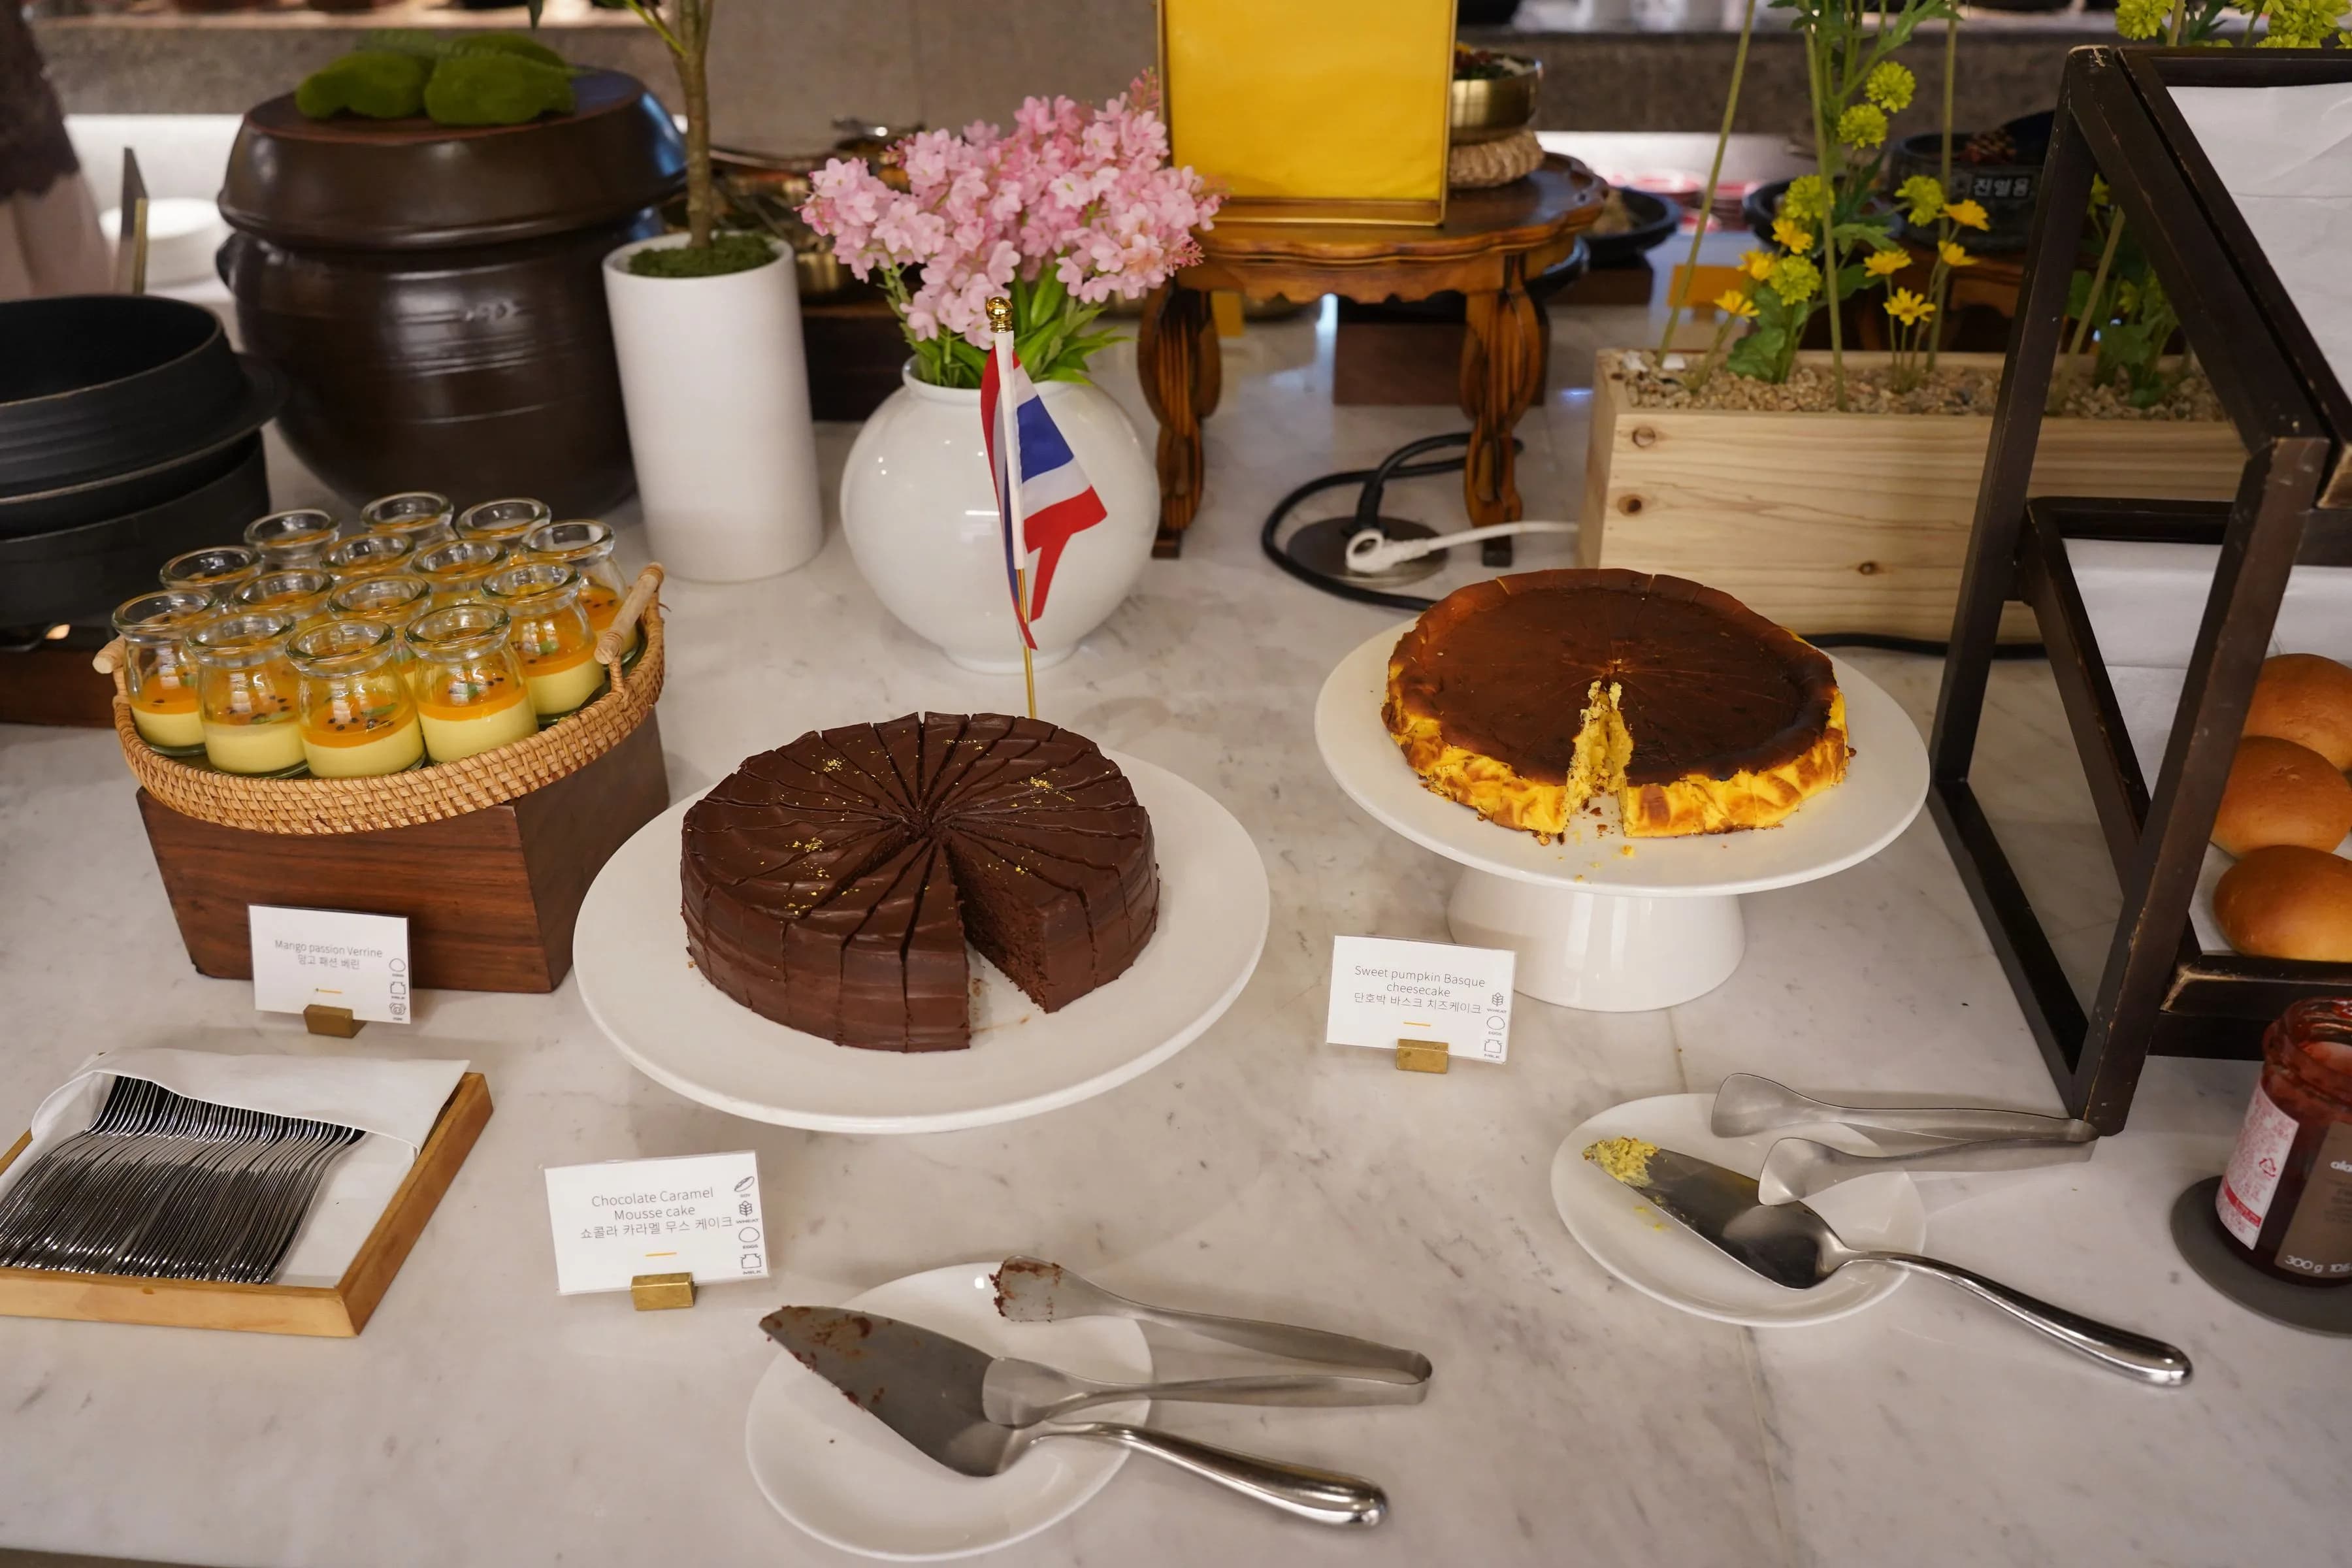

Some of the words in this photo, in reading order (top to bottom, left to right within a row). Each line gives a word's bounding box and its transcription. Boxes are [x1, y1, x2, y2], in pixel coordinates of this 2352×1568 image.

[274, 939, 306, 953] Mango
[309, 943, 345, 955] passion
[347, 946, 384, 958] Verrine
[297, 954, 316, 965] 망고
[319, 956, 338, 968] 패션
[341, 958, 361, 970] 베린
[1354, 965, 1388, 978] Sweet
[1391, 970, 1441, 983] pumpkin
[1444, 973, 1485, 988] Basque
[1386, 982, 1451, 998] cheesecake
[1354, 992, 1386, 1005] 단호박
[1390, 996, 1422, 1007] 바스크
[1427, 998, 1482, 1014] 치즈케이크
[591, 1192, 657, 1207] Chocolate
[660, 1187, 714, 1202] Caramel
[613, 1209, 662, 1221] Mousse
[666, 1205, 696, 1218] cake
[580, 1225, 617, 1239] 쇼콜라
[623, 1221, 661, 1235] 카라멜
[666, 1220, 691, 1233] 무스
[695, 1216, 732, 1230] 케이크
[2284, 1254, 2313, 1269] 300
[2313, 1264, 2324, 1274] g
